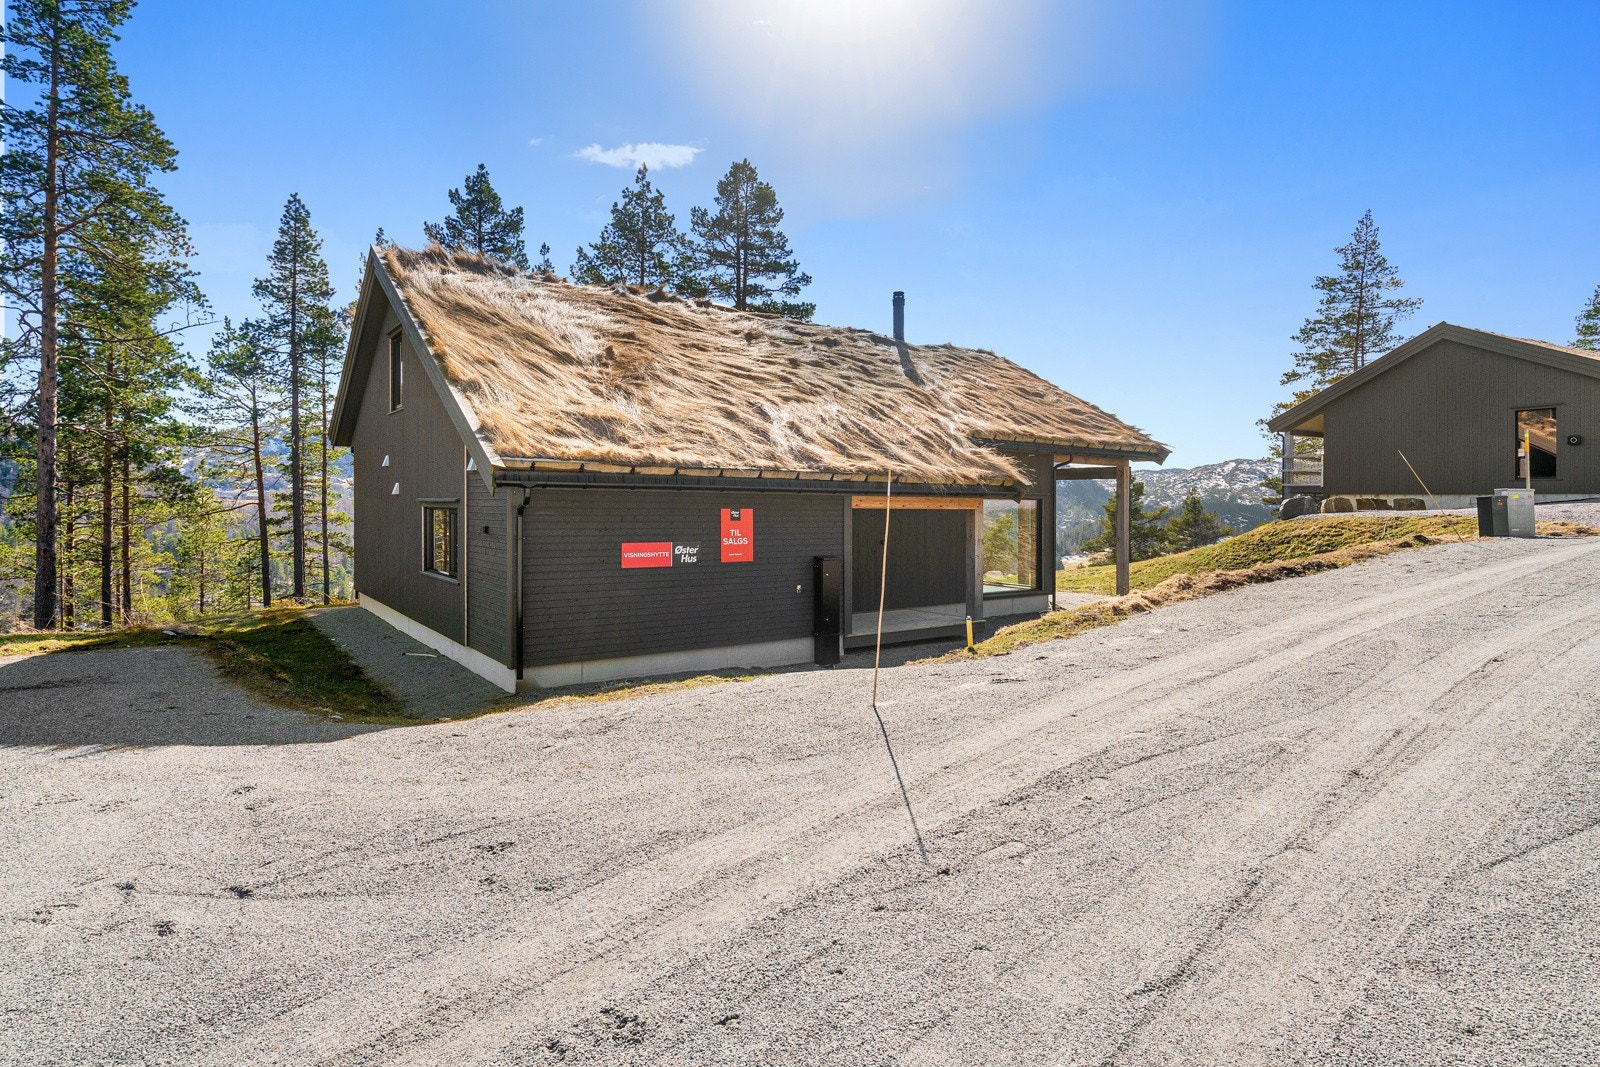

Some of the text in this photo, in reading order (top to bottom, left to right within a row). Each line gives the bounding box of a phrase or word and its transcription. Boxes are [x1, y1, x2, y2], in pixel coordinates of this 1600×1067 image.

[729, 529, 742, 537] TIL
[723, 537, 748, 545] SALGS
[674, 545, 699, 555] Øster
[680, 554, 697, 563] Hus
